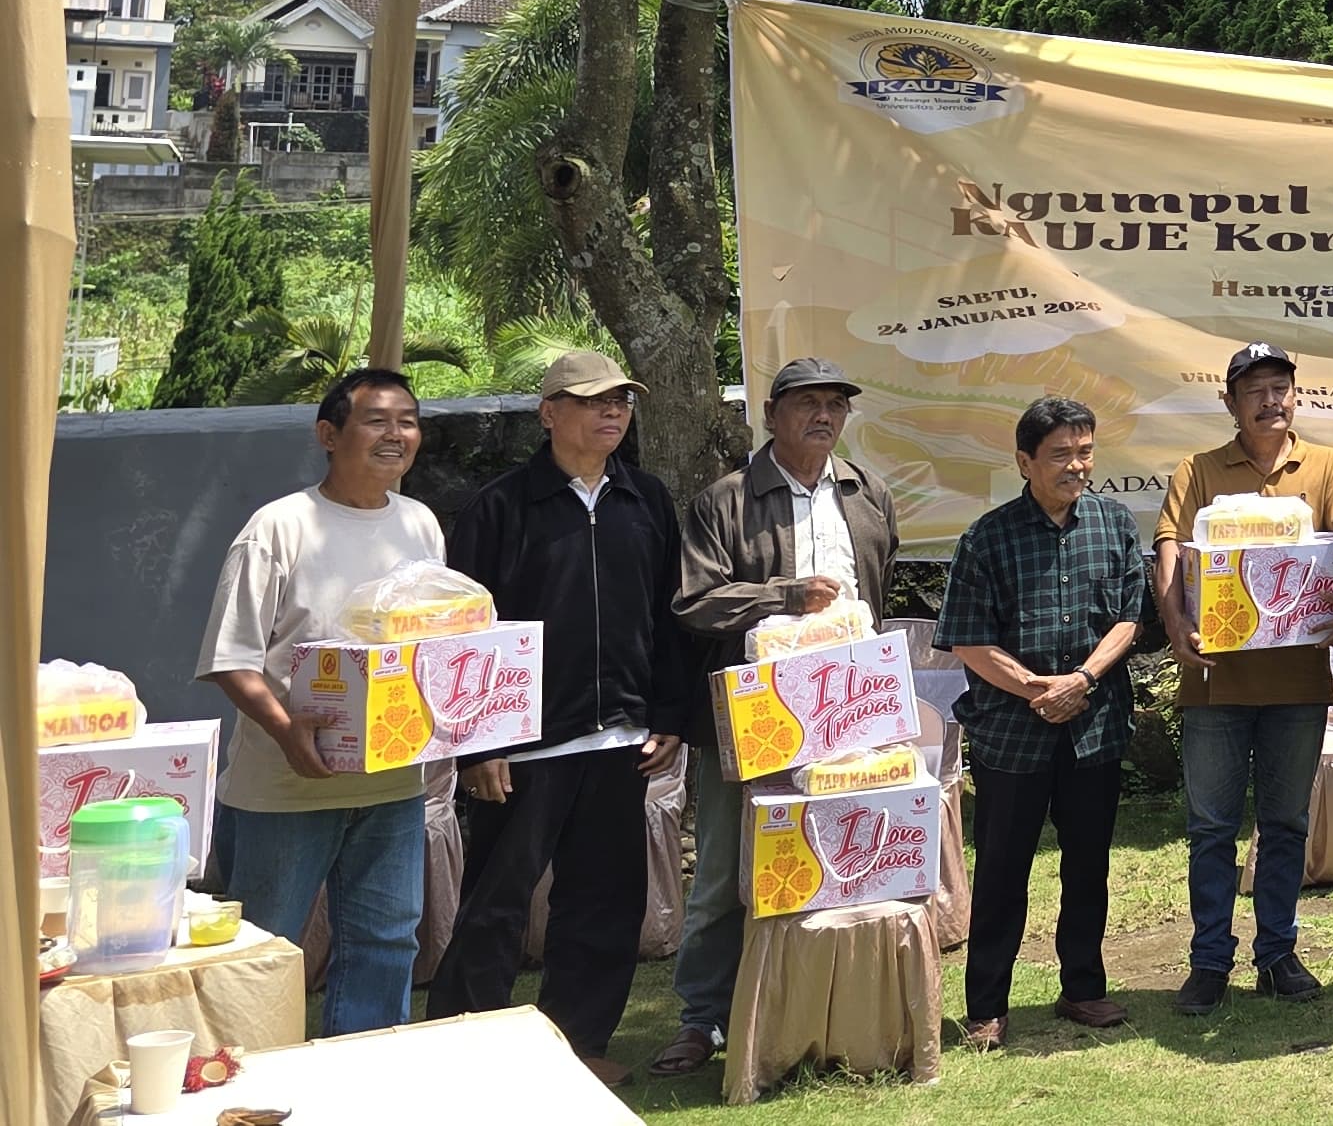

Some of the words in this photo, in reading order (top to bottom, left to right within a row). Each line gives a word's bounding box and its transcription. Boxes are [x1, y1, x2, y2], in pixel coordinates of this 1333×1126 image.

[885, 26, 969, 45] MOJOKERTO
[878, 79, 977, 95] KAUJE
[958, 178, 1311, 223] Ngumpul
[950, 206, 1188, 252] KAUJE
[877, 323, 908, 336] 24
[917, 305, 1037, 332] JANUARI
[1044, 301, 1102, 315] 2026
[937, 287, 1038, 309] SABTU,
[1267, 557, 1299, 609] I
[442, 648, 478, 711] I
[475, 648, 532, 699] Love
[808, 661, 841, 721] I
[841, 664, 902, 704] Love
[44, 713, 97, 738] MANIS
[815, 696, 904, 749] Trawas
[815, 770, 847, 790] TAPE
[832, 807, 869, 865] I
[864, 809, 928, 855] Love
